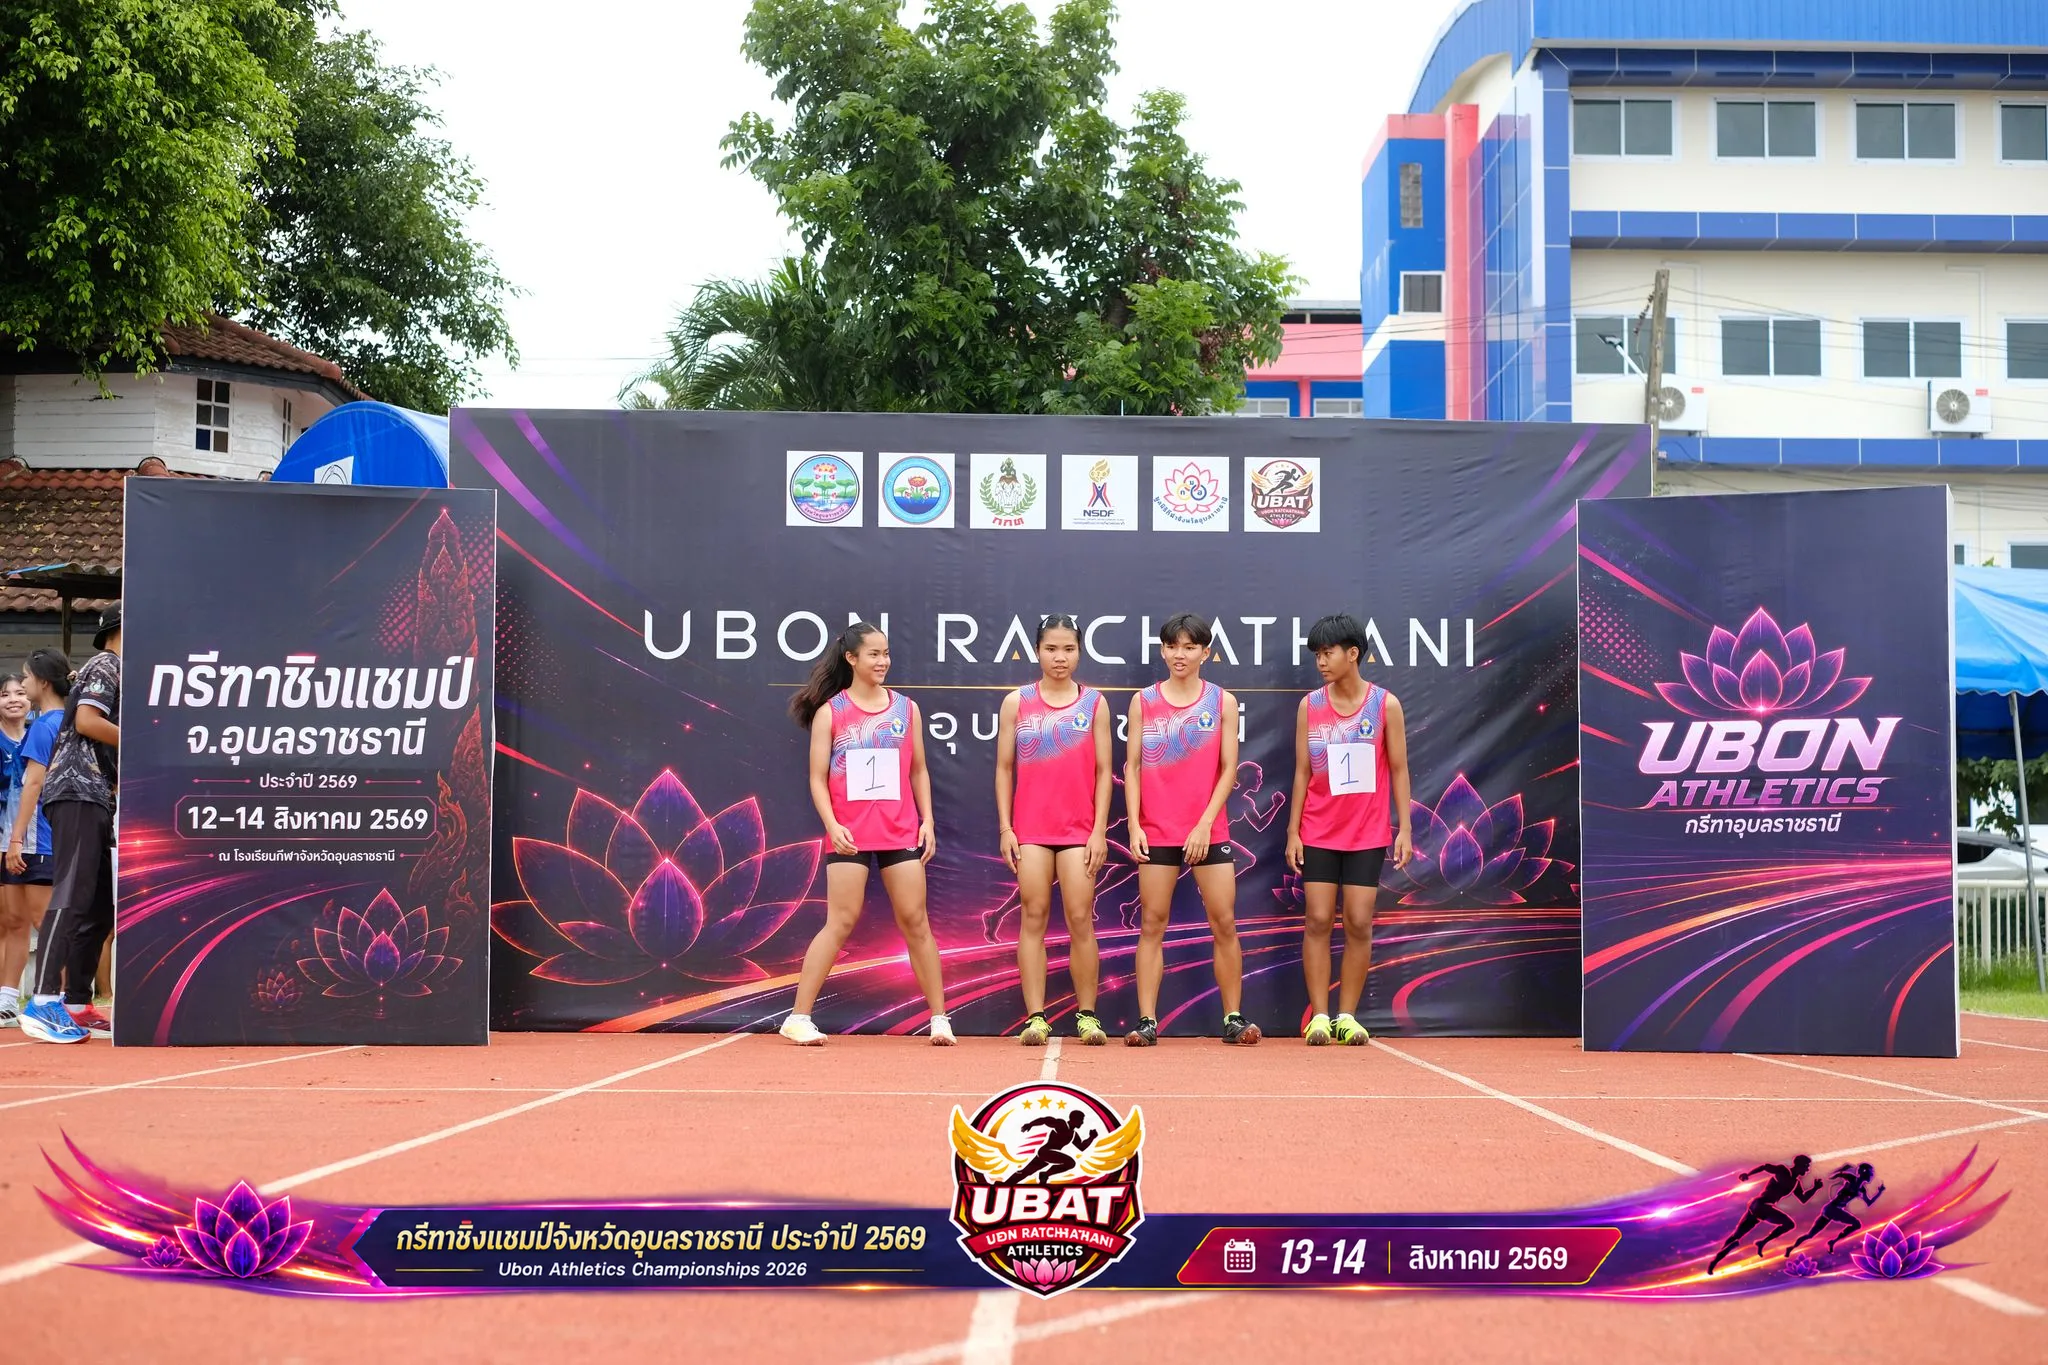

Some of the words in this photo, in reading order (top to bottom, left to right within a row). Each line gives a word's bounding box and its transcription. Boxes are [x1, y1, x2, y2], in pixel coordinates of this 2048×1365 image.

[1083, 509, 1115, 518] NSDF
[1256, 495, 1309, 509] UBAT
[992, 516, 1025, 527] กกท
[936, 612, 1475, 668] RACHATHANI
[148, 650, 475, 710] กรีฑาชิงแชมป์
[187, 717, 427, 766] จ.อุบลราชธานี
[1638, 717, 1903, 774] UBON
[259, 771, 314, 789] ประจำปี
[318, 774, 358, 789] 2569
[865, 755, 885, 791] 1
[1340, 752, 1359, 785] 1
[1648, 777, 1898, 808] ATHLETICS
[273, 806, 362, 830] สิงหาคม
[369, 808, 429, 830] 2569
[1684, 812, 1843, 839] กรีฑาอุบลราชธานี
[218, 852, 231, 862] ณ
[233, 848, 395, 865] โรงเรียนกีฬาจังหวัดอุบลราชธานี
